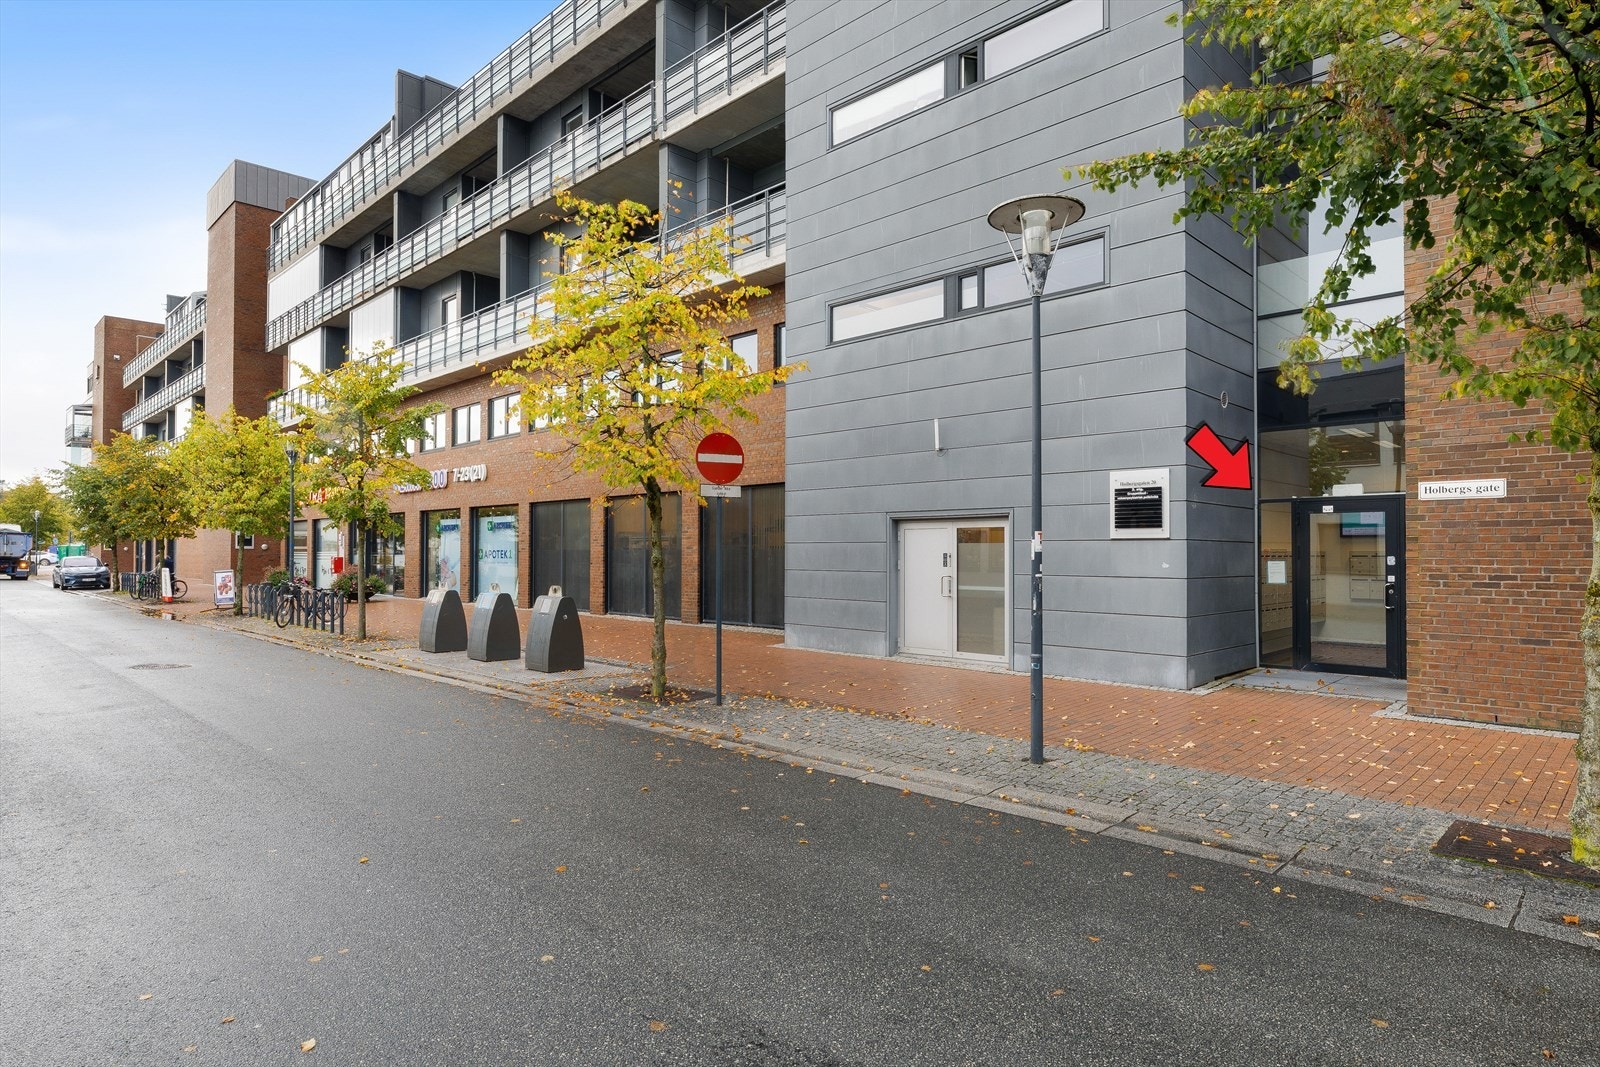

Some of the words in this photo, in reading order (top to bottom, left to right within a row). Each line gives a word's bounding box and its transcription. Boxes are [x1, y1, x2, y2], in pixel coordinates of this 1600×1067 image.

[1424, 486, 1472, 495] Holbergs
[1475, 484, 1500, 494] gate
[484, 549, 508, 559] APOTEK
